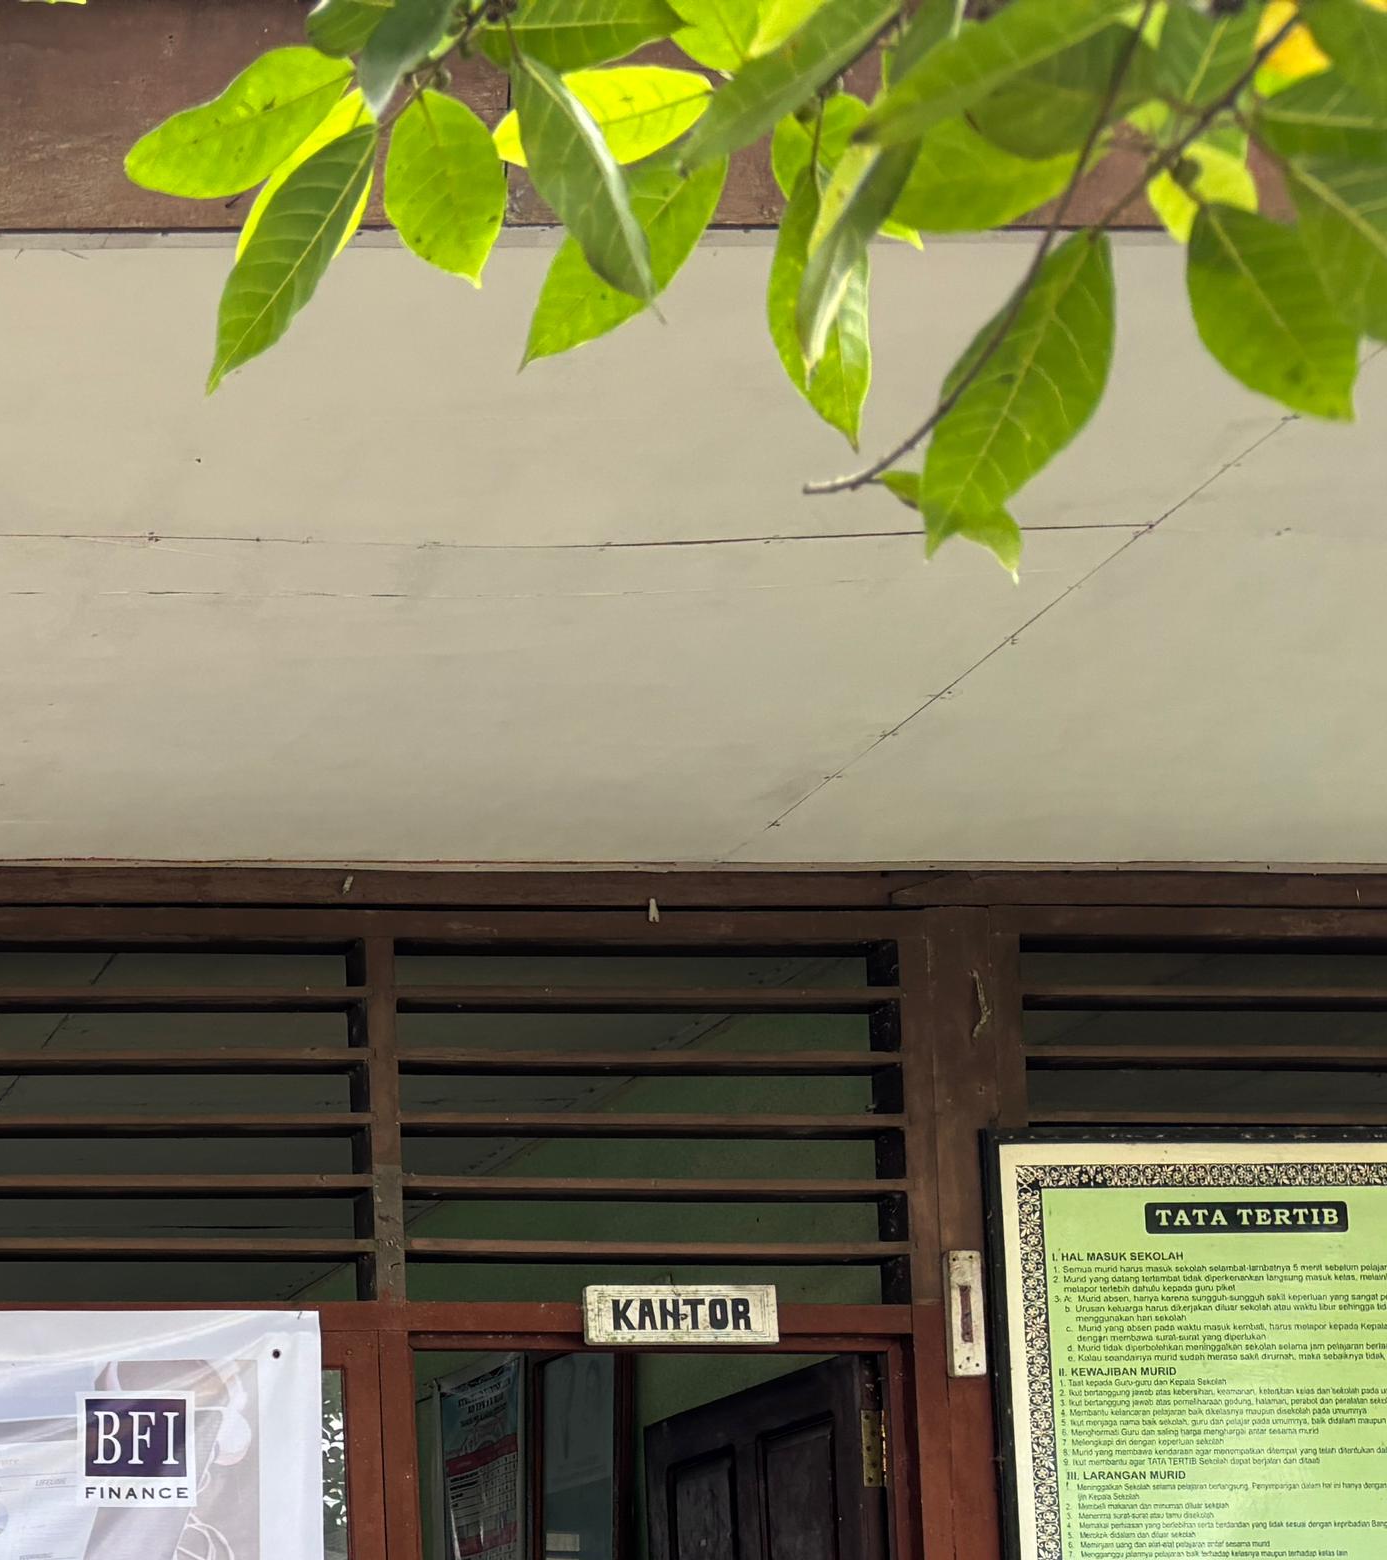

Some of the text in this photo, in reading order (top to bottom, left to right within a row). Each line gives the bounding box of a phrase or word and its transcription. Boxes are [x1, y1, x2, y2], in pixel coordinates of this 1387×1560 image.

[1156, 1208, 1339, 1226] TATA TERTIB
[1061, 1253, 1084, 1262] HAL
[1087, 1252, 1127, 1261] MASUK
[1130, 1251, 1184, 1261] SEKOLAH
[1146, 1265, 1173, 1273] masuk
[1293, 1264, 1299, 1272] 5
[1300, 1264, 1323, 1272] menit
[1325, 1264, 1359, 1272] sebelum
[1111, 1276, 1140, 1284] datang
[1183, 1274, 1202, 1282] tidak
[1204, 1274, 1265, 1283] diperkenankan
[1266, 1274, 1303, 1283] langsung
[1063, 1284, 1236, 1294] melapor terlebih dahulu kepada guru piket
[612, 1298, 752, 1331] KANTOR
[1075, 1314, 1187, 1324] menggunakan hari sekolah
[1077, 1333, 1267, 1343] dengan membawa surat-surat yang diperlukan
[1077, 1344, 1101, 1352] Murid
[1245, 1343, 1276, 1351] sekolah
[1327, 1342, 1364, 1351] pelajaran
[1058, 1366, 1177, 1377] II. KEWAJIBAN MURID
[1085, 1379, 1113, 1387] kepada
[1114, 1379, 1152, 1387] Guru-guru
[1154, 1378, 1168, 1386] dan
[1169, 1378, 1195, 1386] Kepala
[93, 1411, 179, 1464] BFI
[1066, 1470, 1186, 1481] III. LARANGAN MURID
[85, 1487, 189, 1499] FINANCE
